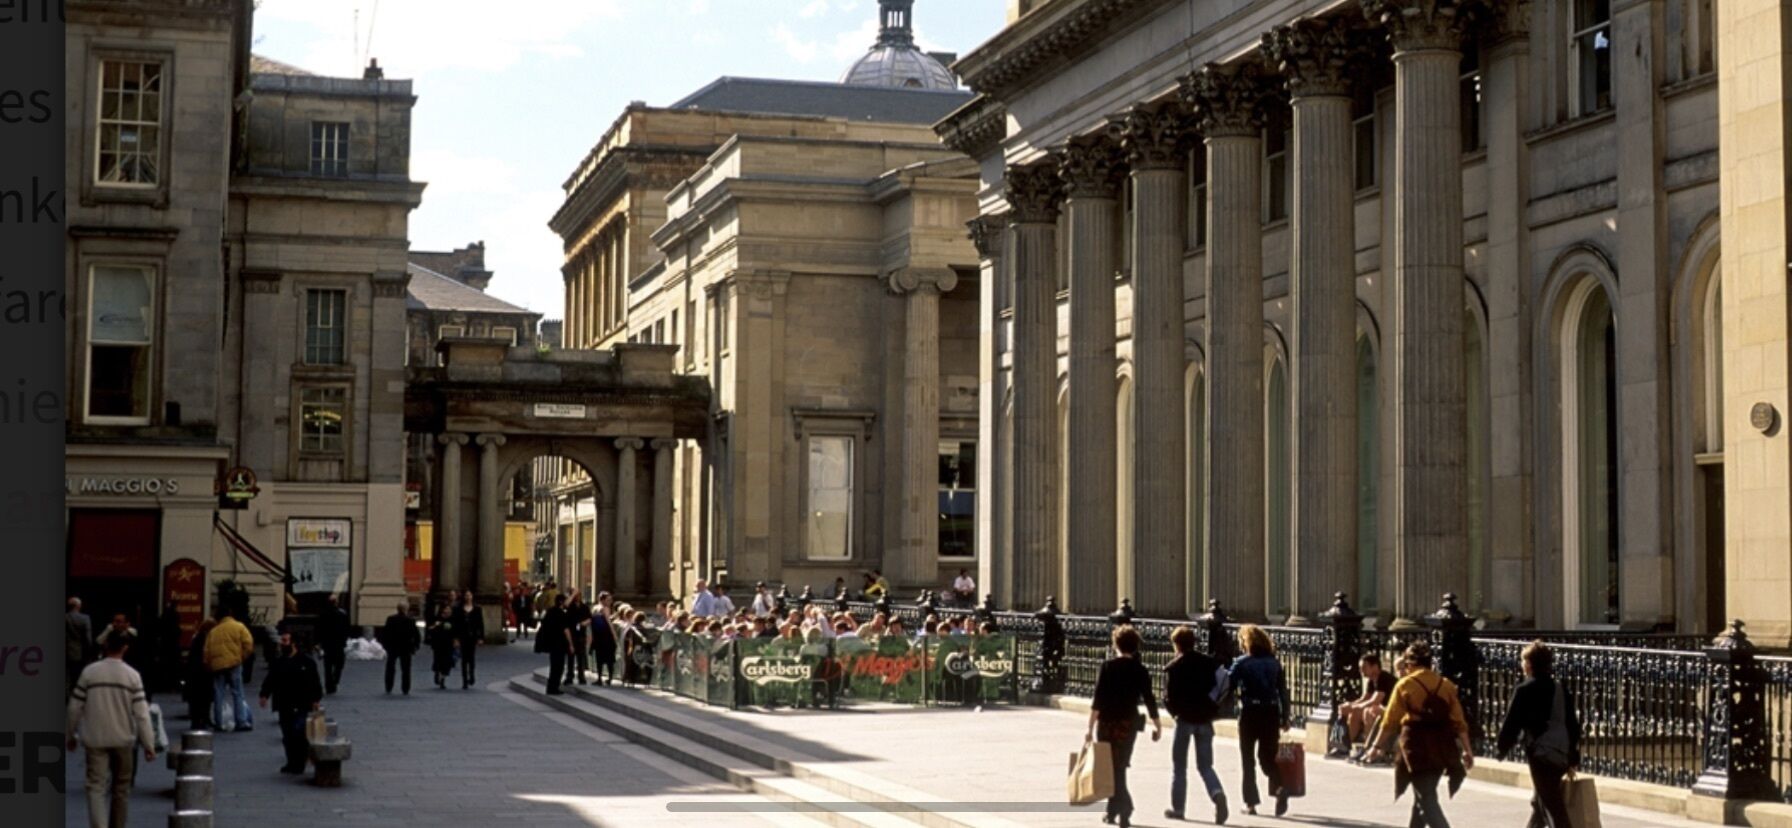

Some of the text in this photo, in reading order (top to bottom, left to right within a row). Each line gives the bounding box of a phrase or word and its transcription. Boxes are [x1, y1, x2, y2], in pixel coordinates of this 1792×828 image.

[80, 478, 178, 493] MAGGIO'S
[740, 655, 811, 681] Carlsberg
[945, 651, 1013, 675] Carlsberg
